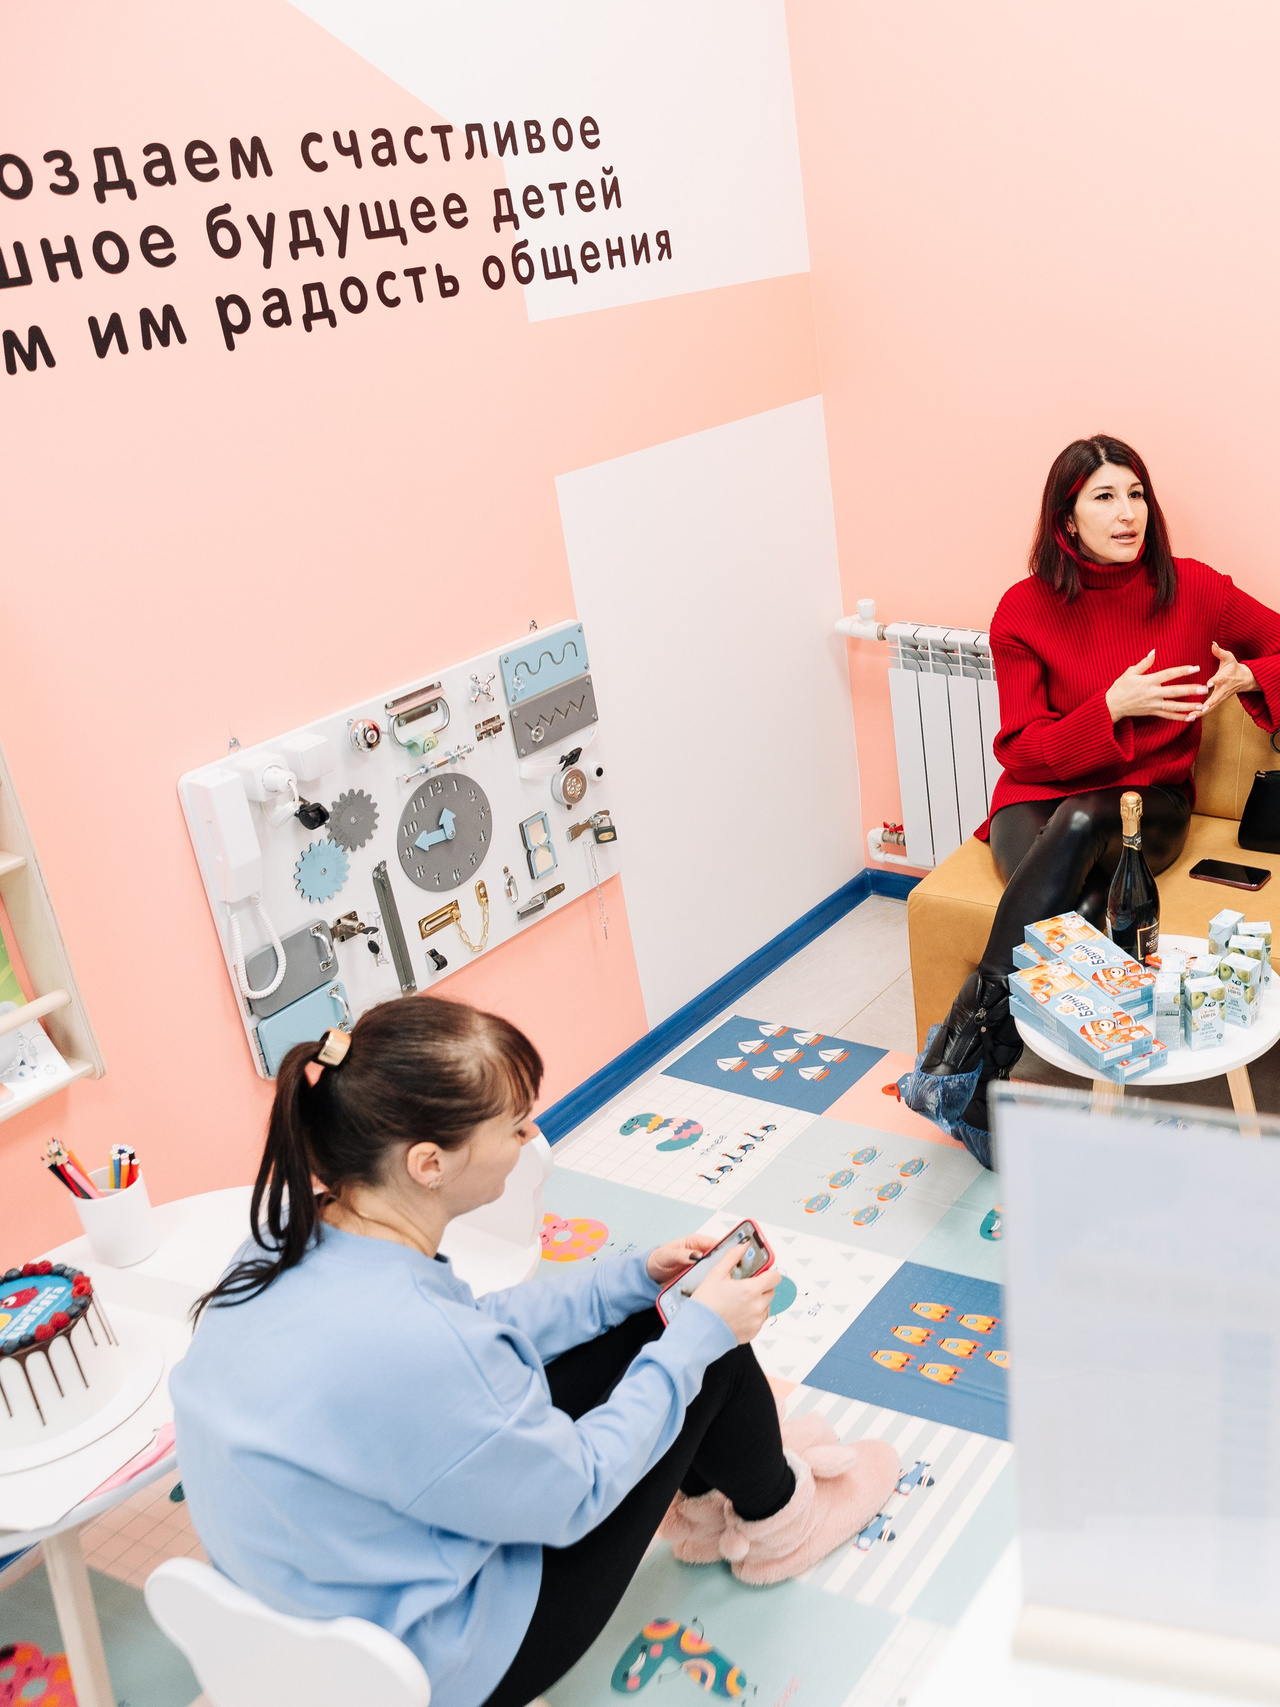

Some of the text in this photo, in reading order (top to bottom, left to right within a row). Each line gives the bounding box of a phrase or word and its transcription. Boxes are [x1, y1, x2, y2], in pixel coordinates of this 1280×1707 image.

[0, 116, 600, 203] оздаем счастливое
[206, 193, 468, 269] будущее
[493, 166, 621, 233] детей
[88, 304, 187, 358] им
[216, 264, 459, 351] радость
[483, 230, 671, 290] общения
[428, 781, 444, 797] 12
[452, 779, 460, 792] 1
[469, 789, 477, 802] 2
[412, 796, 427, 813] 11
[478, 806, 486, 820] 3
[403, 820, 419, 837] 10
[480, 830, 487, 842] 4
[405, 846, 415, 860] 9
[469, 852, 478, 866] 5
[416, 864, 425, 879] 8
[433, 872, 441, 885] 7
[452, 868, 461, 881] 6
[1074, 944, 1106, 966] Барни
[1062, 994, 1095, 1018] Барни
[700, 1134, 728, 1157] three
